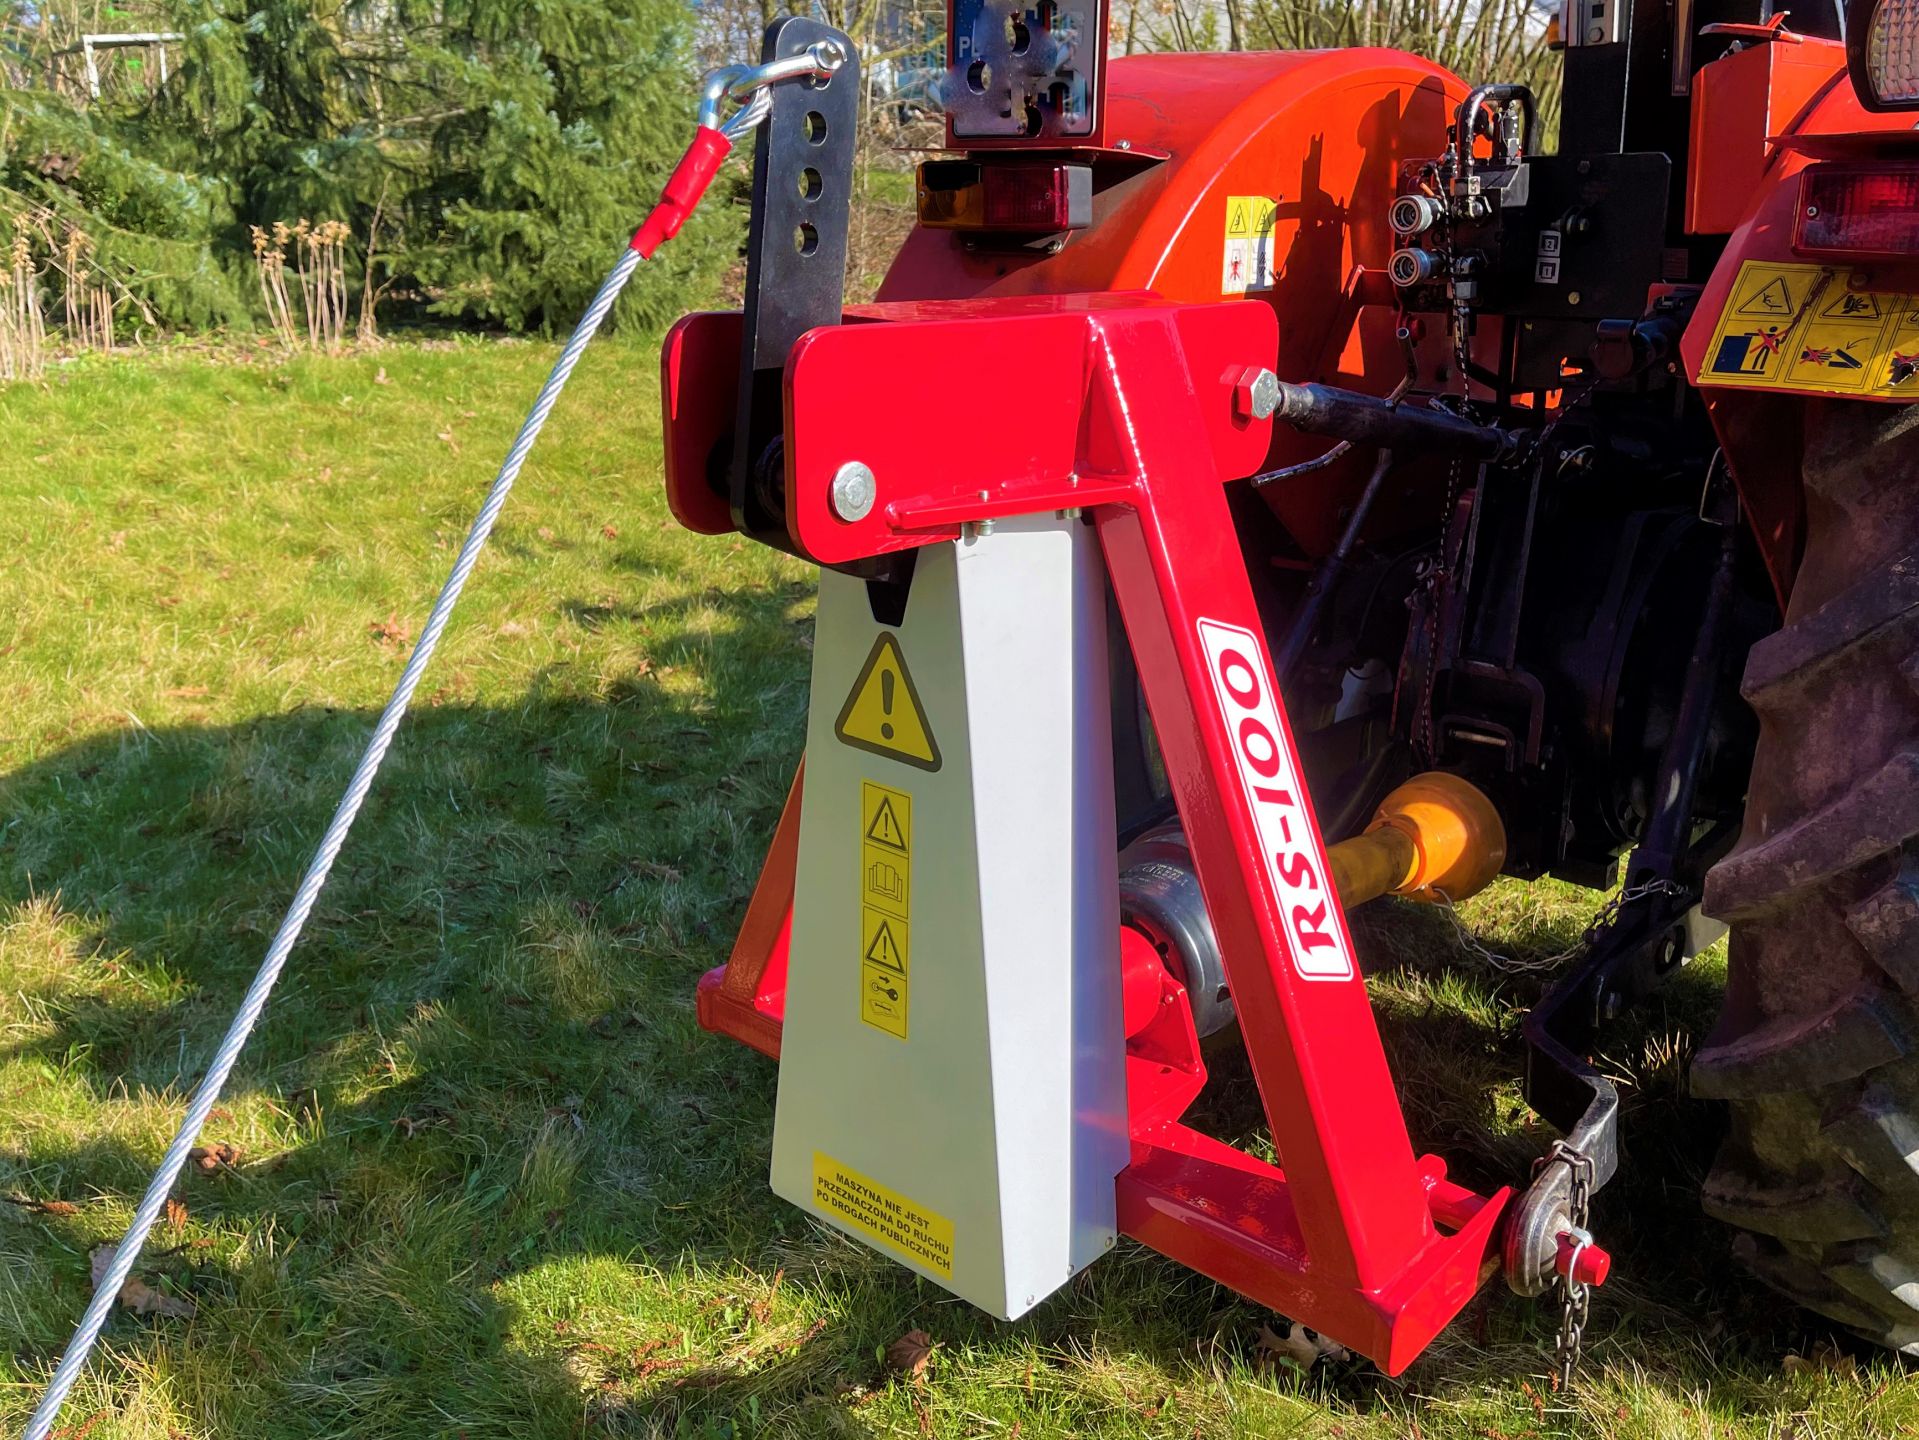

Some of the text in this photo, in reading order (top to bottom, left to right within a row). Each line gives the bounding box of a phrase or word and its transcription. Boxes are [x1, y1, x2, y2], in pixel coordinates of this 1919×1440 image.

[1219, 648, 1337, 956] RS-100
[816, 1189, 950, 1271] PO DROGACH PUBLICZNYCH
[818, 1176, 949, 1255] PRZEZNACZONA DO RUCHU
[836, 1172, 929, 1230] MASZYNA NIE JEST
